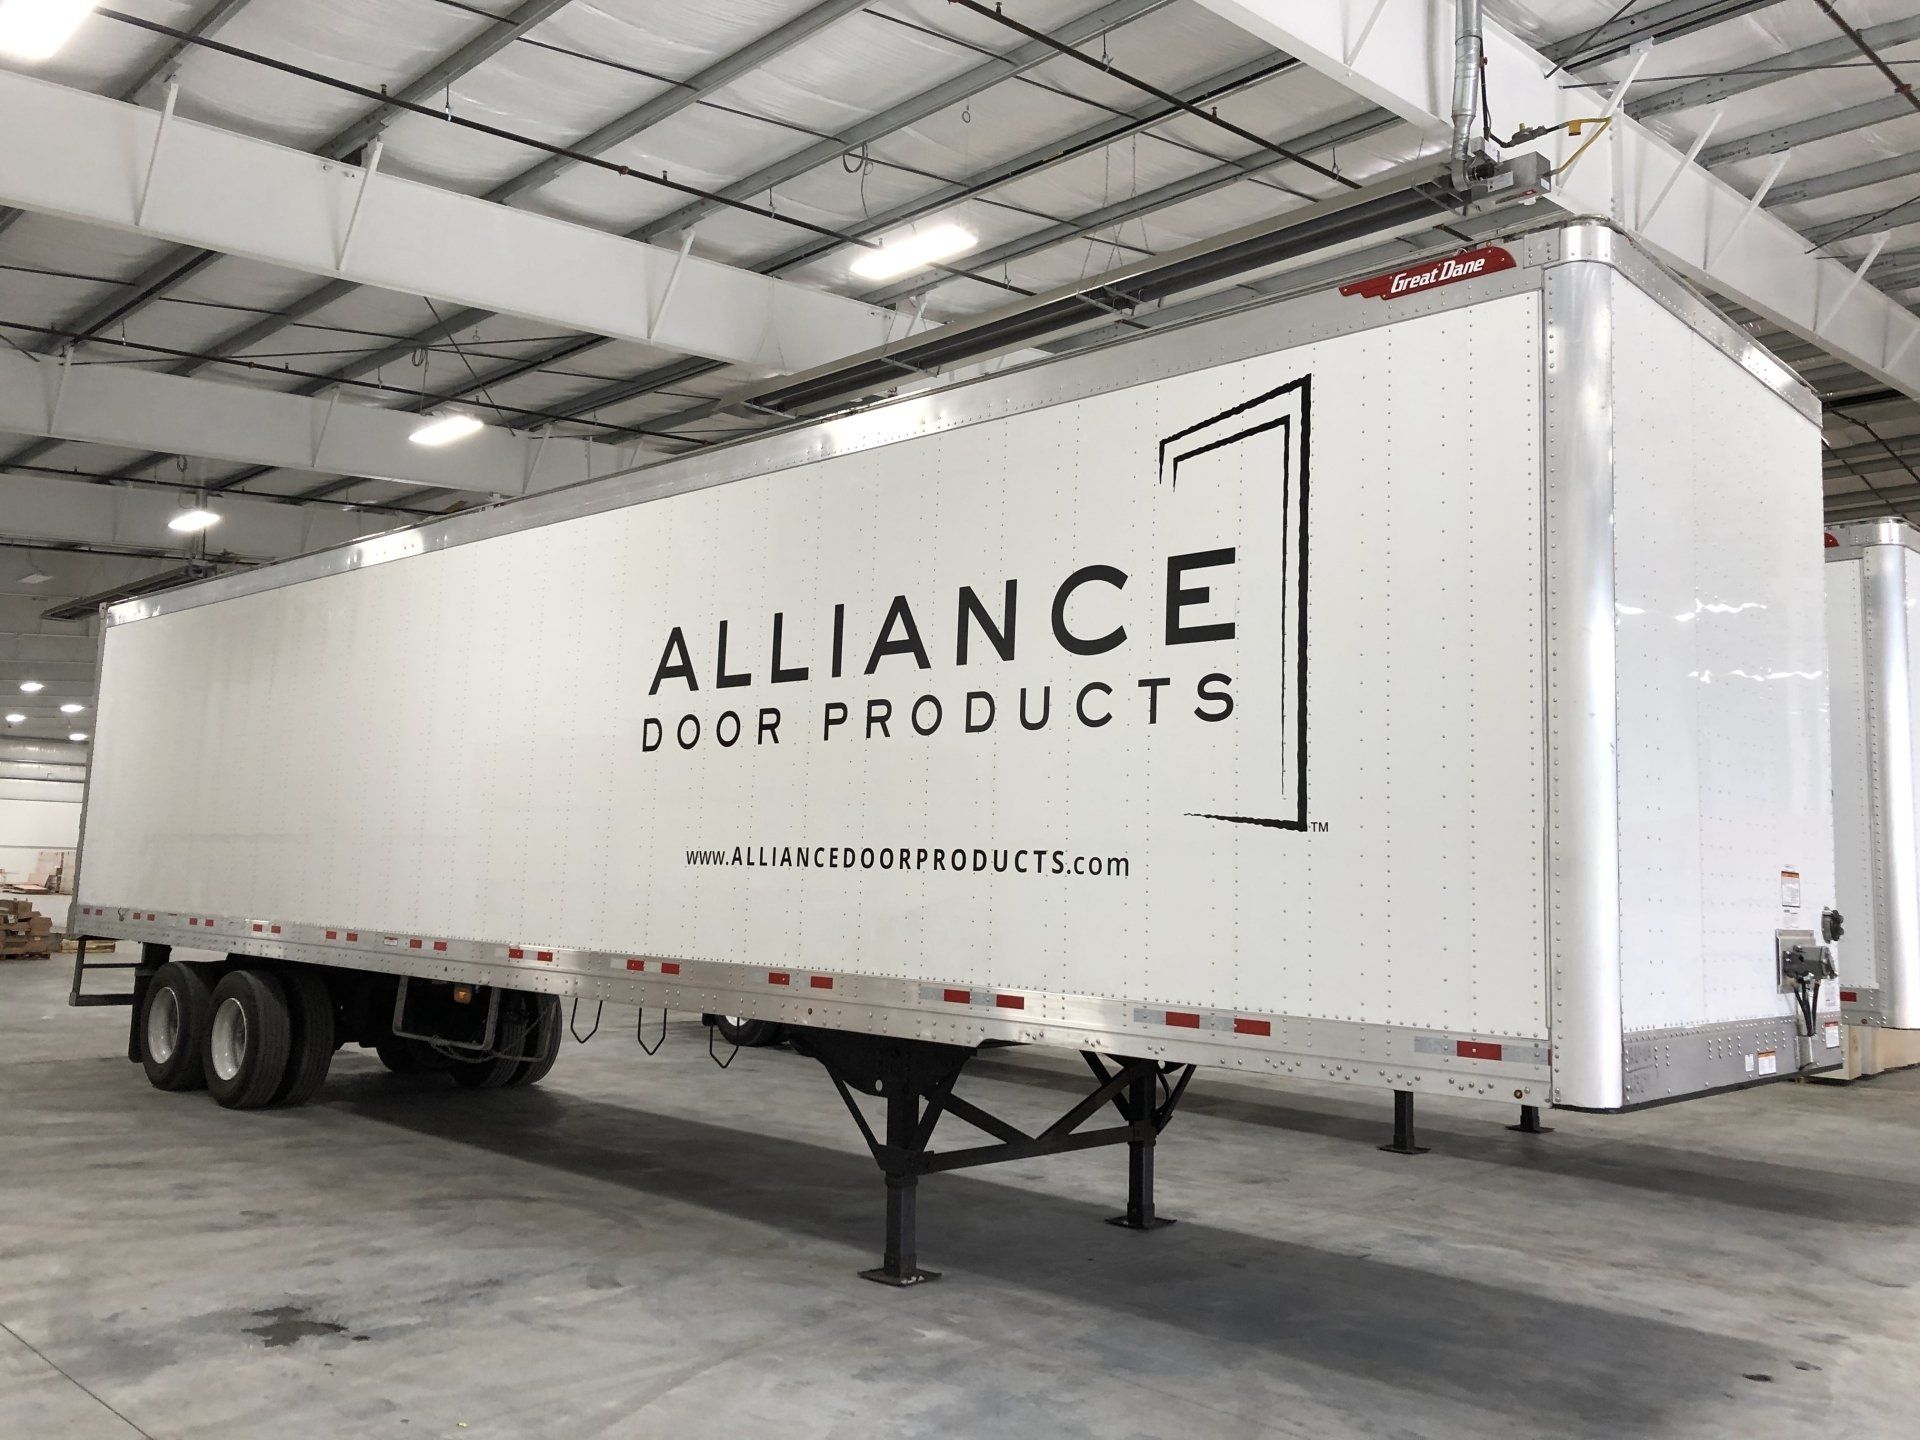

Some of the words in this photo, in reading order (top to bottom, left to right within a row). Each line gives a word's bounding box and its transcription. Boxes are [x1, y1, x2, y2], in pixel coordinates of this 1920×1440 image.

[1390, 267, 1439, 294] Great
[1438, 258, 1486, 281] Dane
[649, 547, 1236, 696] ALLIANCE
[642, 707, 781, 753] DOOR
[823, 673, 1234, 741] PRODUCTS
[686, 846, 1129, 877] www.ALLIANCEDOORPRODUCTS.com
